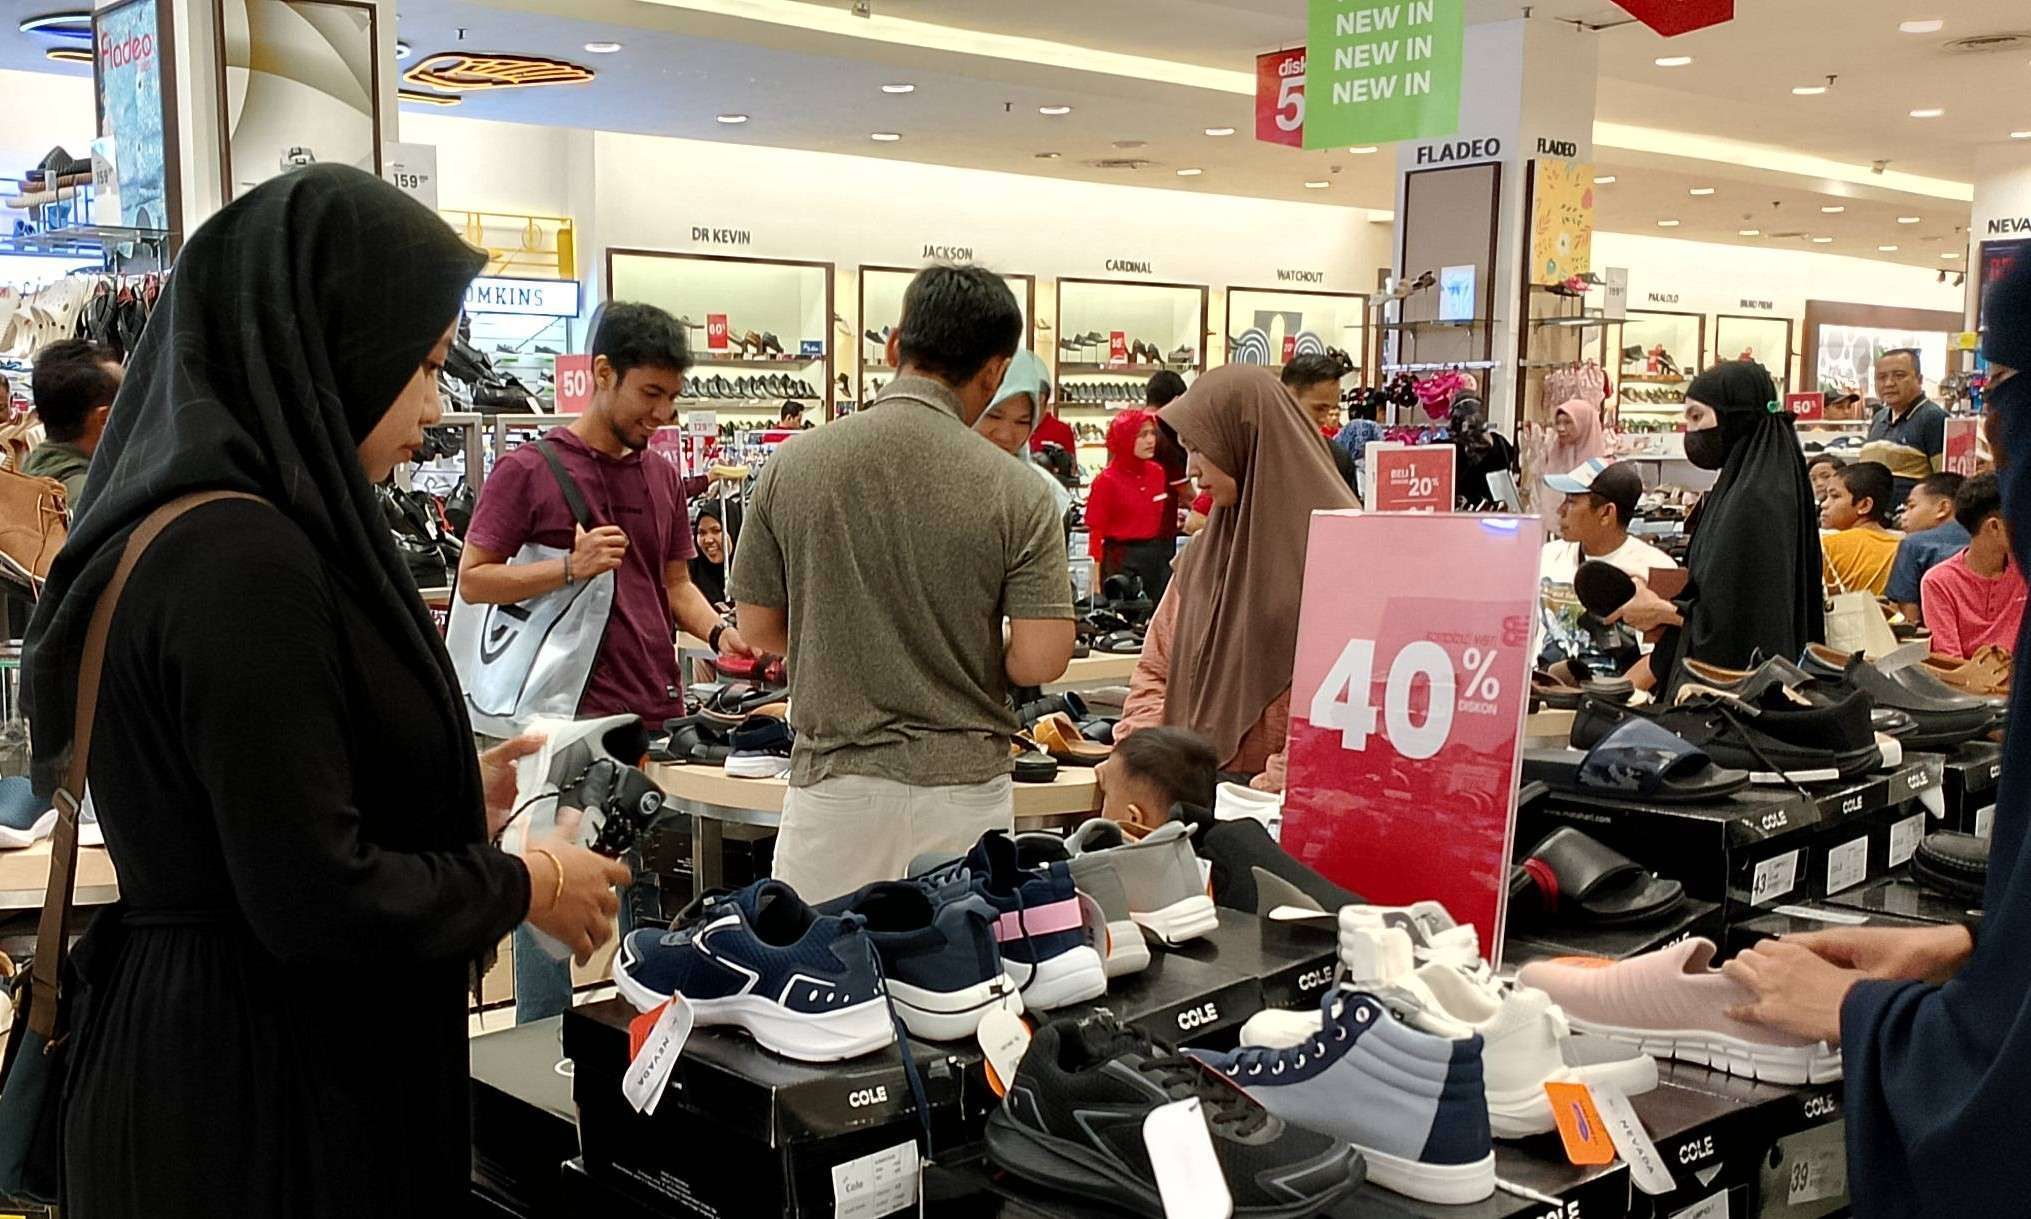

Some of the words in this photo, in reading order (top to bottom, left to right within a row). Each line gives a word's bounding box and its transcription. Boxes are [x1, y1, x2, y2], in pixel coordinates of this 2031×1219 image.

[1336, 4, 1400, 37] NEW
[1408, 0, 1434, 26] IN
[1334, 39, 1399, 71] NEW
[1406, 34, 1432, 62] IN
[1333, 74, 1398, 105] NEW
[1404, 69, 1431, 97] IN
[1416, 137, 1500, 165] FLADEO
[1536, 137, 1577, 158] FLADEO
[393, 173, 418, 189] 159
[692, 226, 710, 243] DR
[713, 228, 751, 244] KEVIN
[922, 244, 973, 260] JACKSON
[1105, 259, 1153, 274] CARDINAL
[1276, 268, 1324, 284] WATCHOUT
[1458, 698, 1498, 716] DISKON
[1907, 768, 1929, 790] COLE
[1842, 794, 1863, 815] COLE
[1761, 809, 1788, 831] COLE
[1298, 965, 1334, 991] COLE
[1177, 1002, 1219, 1031] COLE
[637, 1036, 670, 1086] NEVADA
[849, 1085, 888, 1108] COLE
[1803, 1094, 1837, 1118] COLE
[1620, 1119, 1654, 1174] NEVADA
[1679, 1135, 1715, 1165] COLE
[1791, 1161, 1809, 1193] 39
